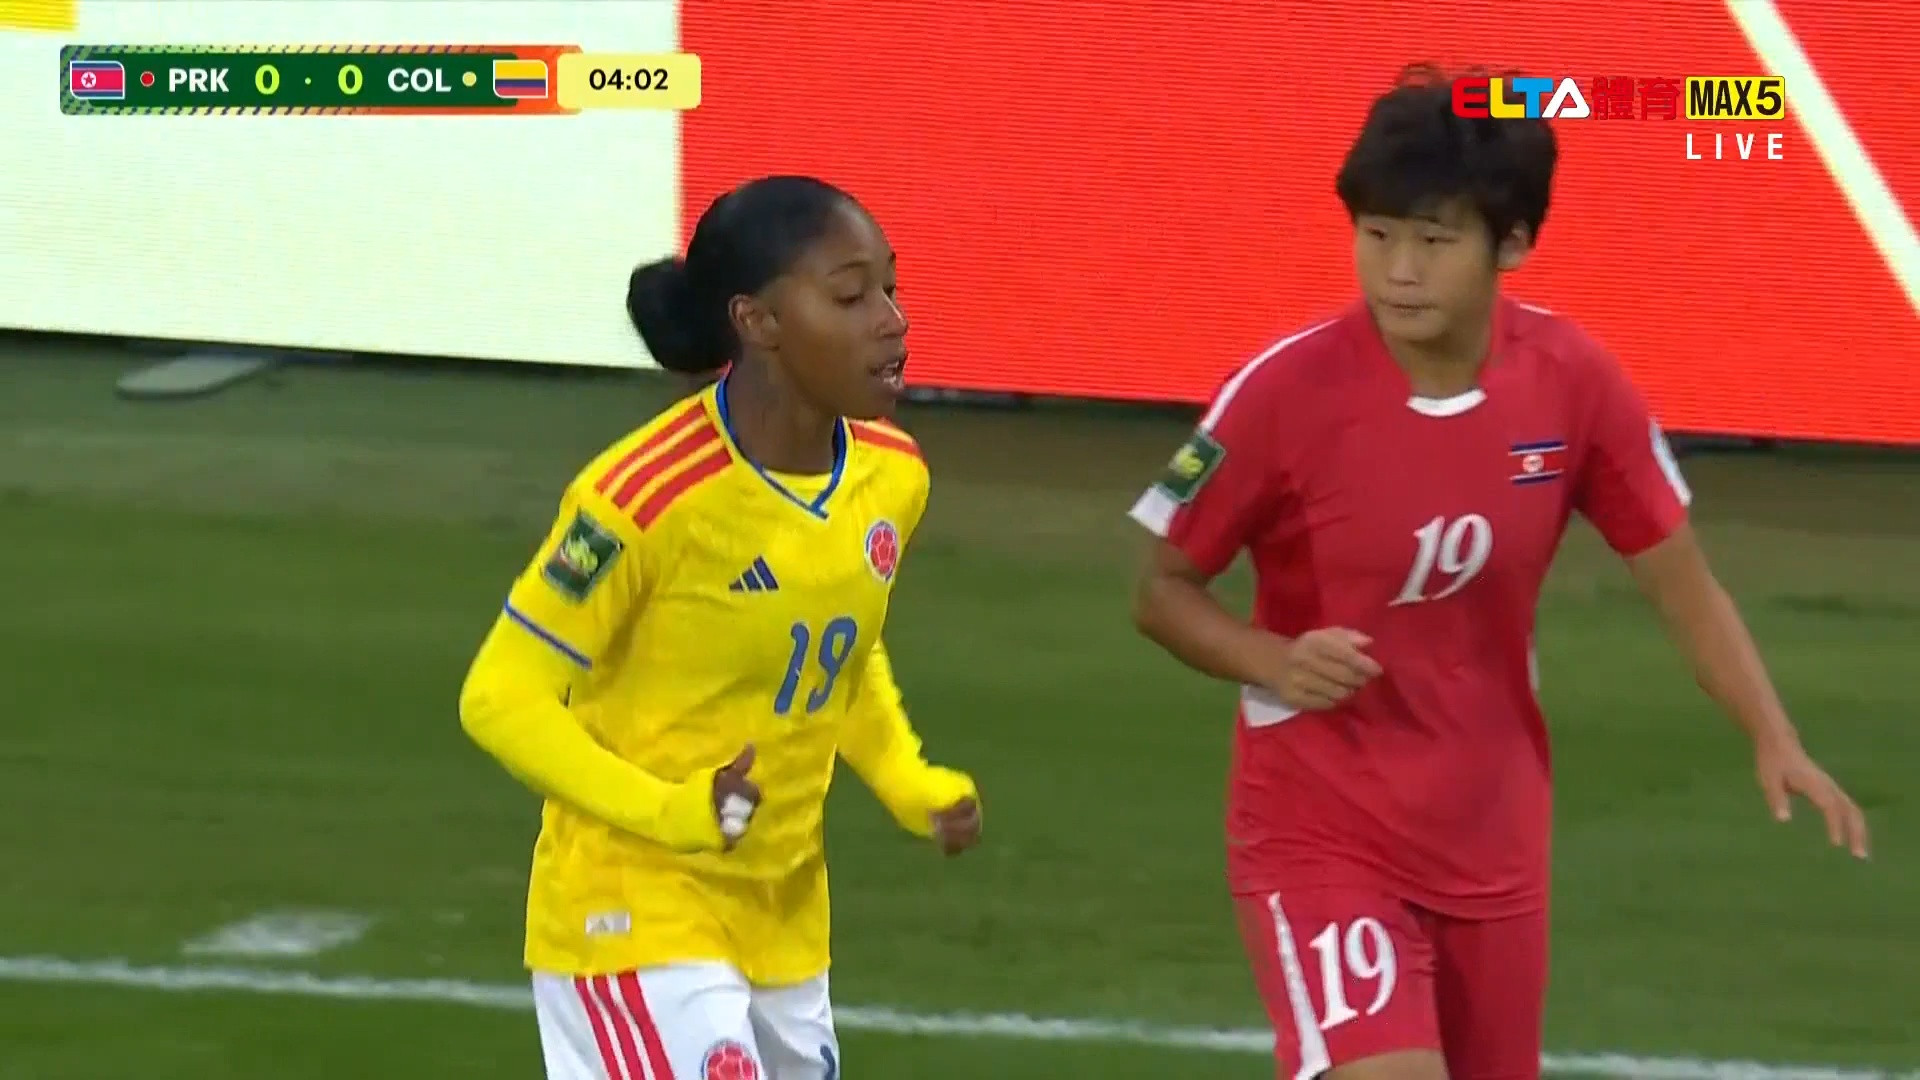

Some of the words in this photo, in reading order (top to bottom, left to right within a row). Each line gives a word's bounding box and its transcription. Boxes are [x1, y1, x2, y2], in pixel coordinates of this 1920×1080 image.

[1387, 513, 1493, 606] 19
[773, 615, 858, 715] 19
[1308, 917, 1398, 1030] 19
